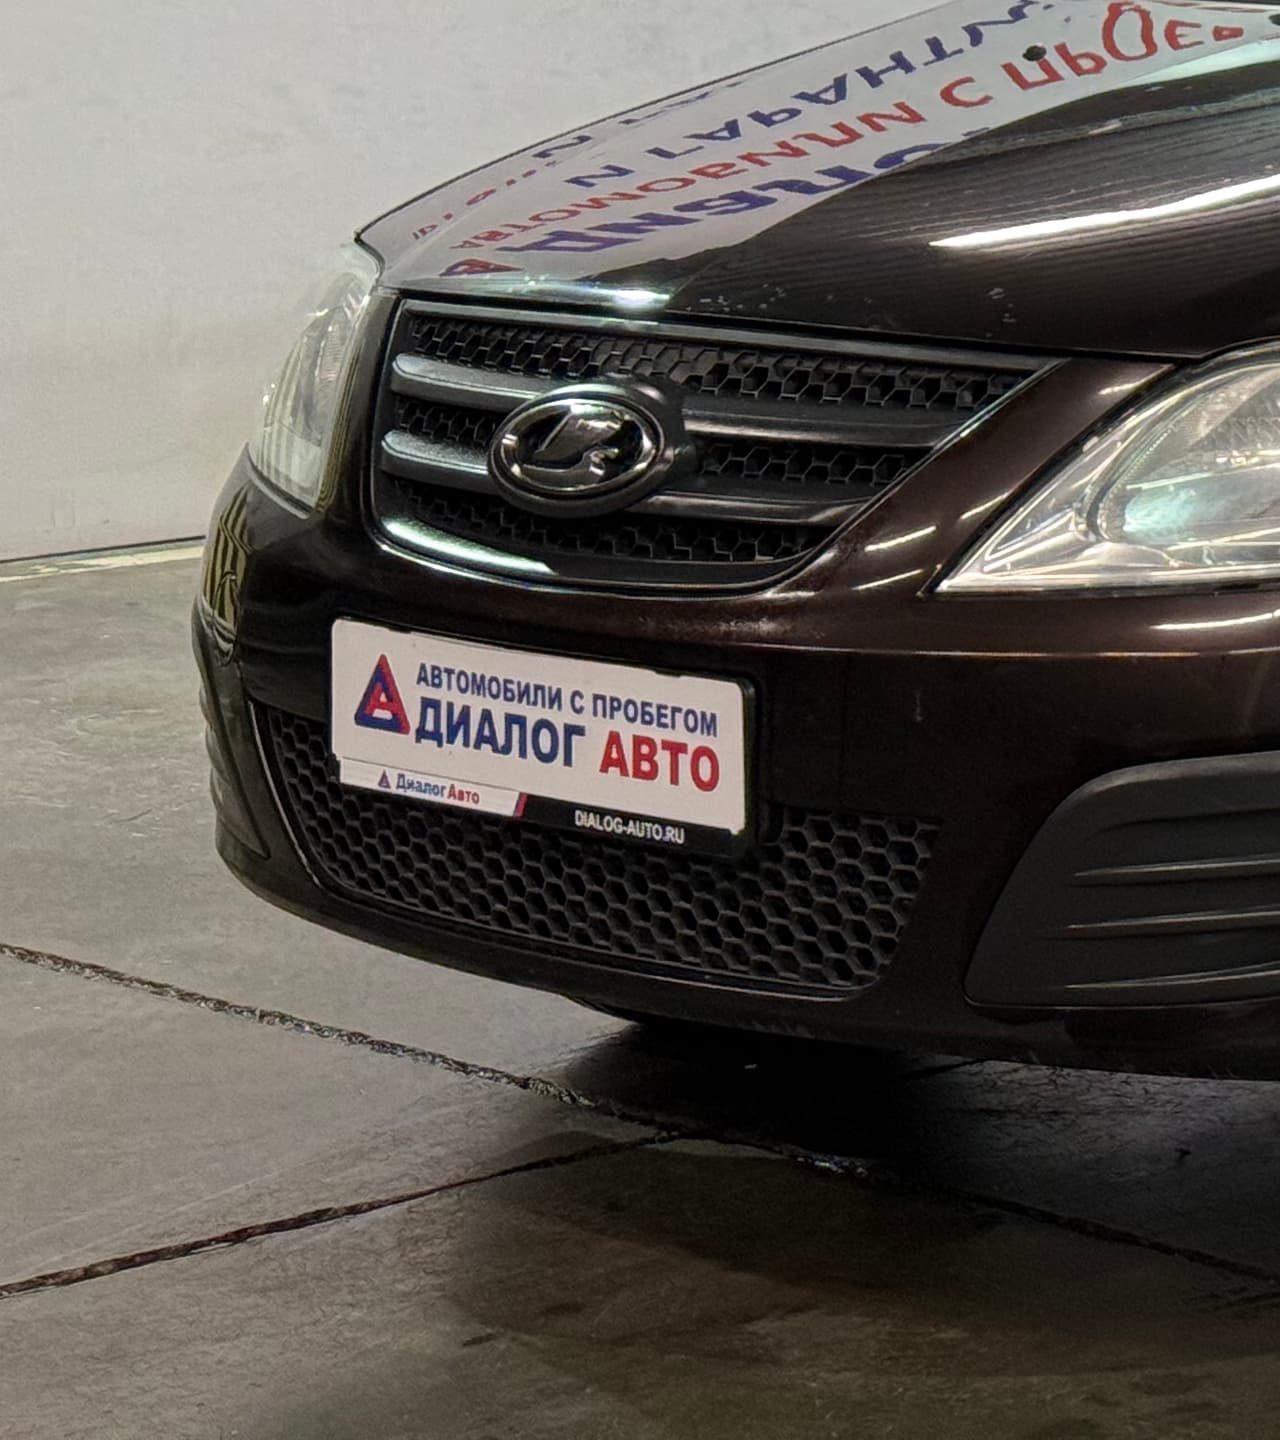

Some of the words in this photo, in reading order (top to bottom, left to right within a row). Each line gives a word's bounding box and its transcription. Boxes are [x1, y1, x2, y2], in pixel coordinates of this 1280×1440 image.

[416, 662, 563, 712] АВТОМОБИЛИ
[569, 690, 586, 715] С
[592, 692, 718, 738] ПРОБЕГОМ
[415, 696, 586, 768] ДИАЛОГ
[599, 730, 720, 793] АВТО
[396, 772, 447, 799] Диалог
[447, 782, 481, 806] Авто
[574, 809, 686, 846] DIALOG-AUTO.RU
